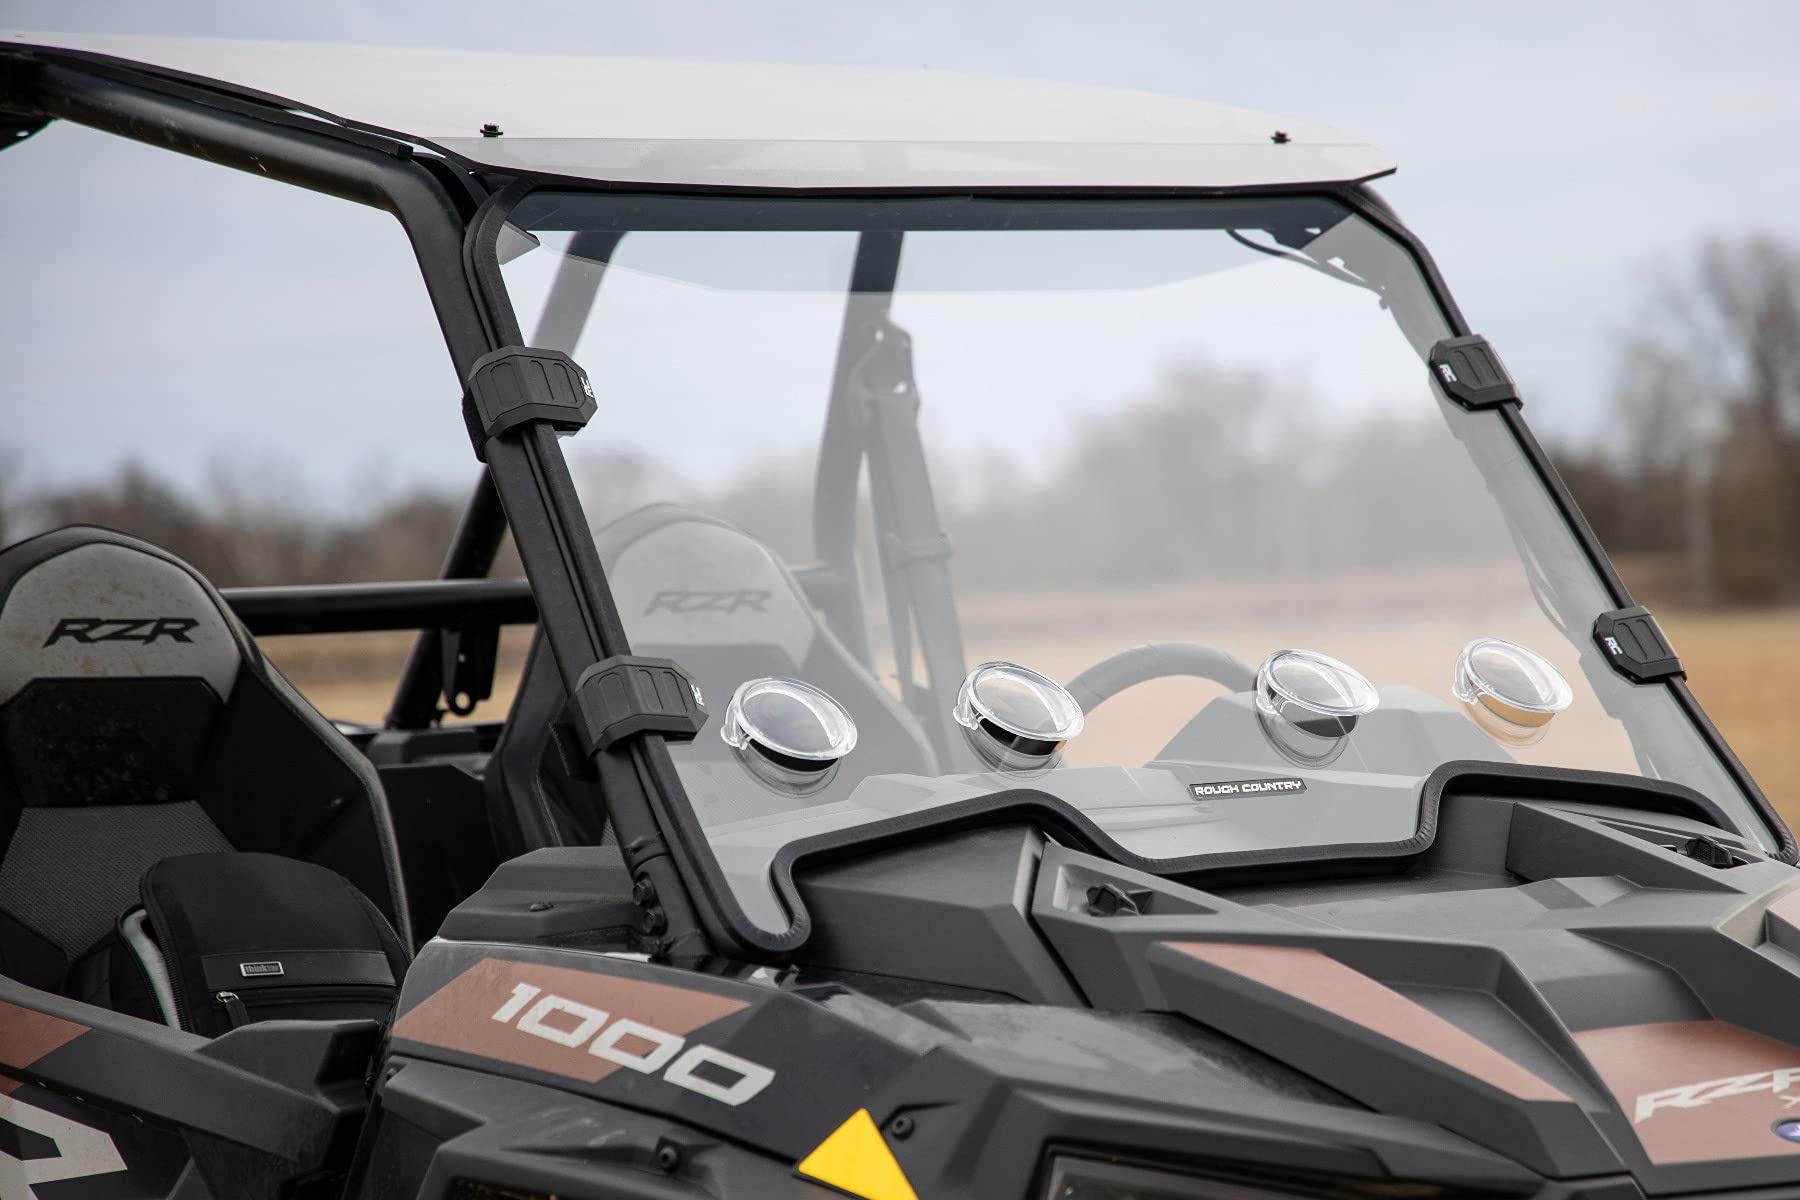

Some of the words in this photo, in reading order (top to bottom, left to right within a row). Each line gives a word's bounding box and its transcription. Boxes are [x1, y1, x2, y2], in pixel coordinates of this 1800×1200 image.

[1439, 364, 1457, 382] RC
[641, 590, 773, 617] RZR
[42, 617, 200, 649] RZR
[1604, 636, 1623, 655] RC
[1194, 785, 1240, 796] ROUGH
[1241, 780, 1302, 792] COUNTRY
[491, 982, 776, 1107] 1000
